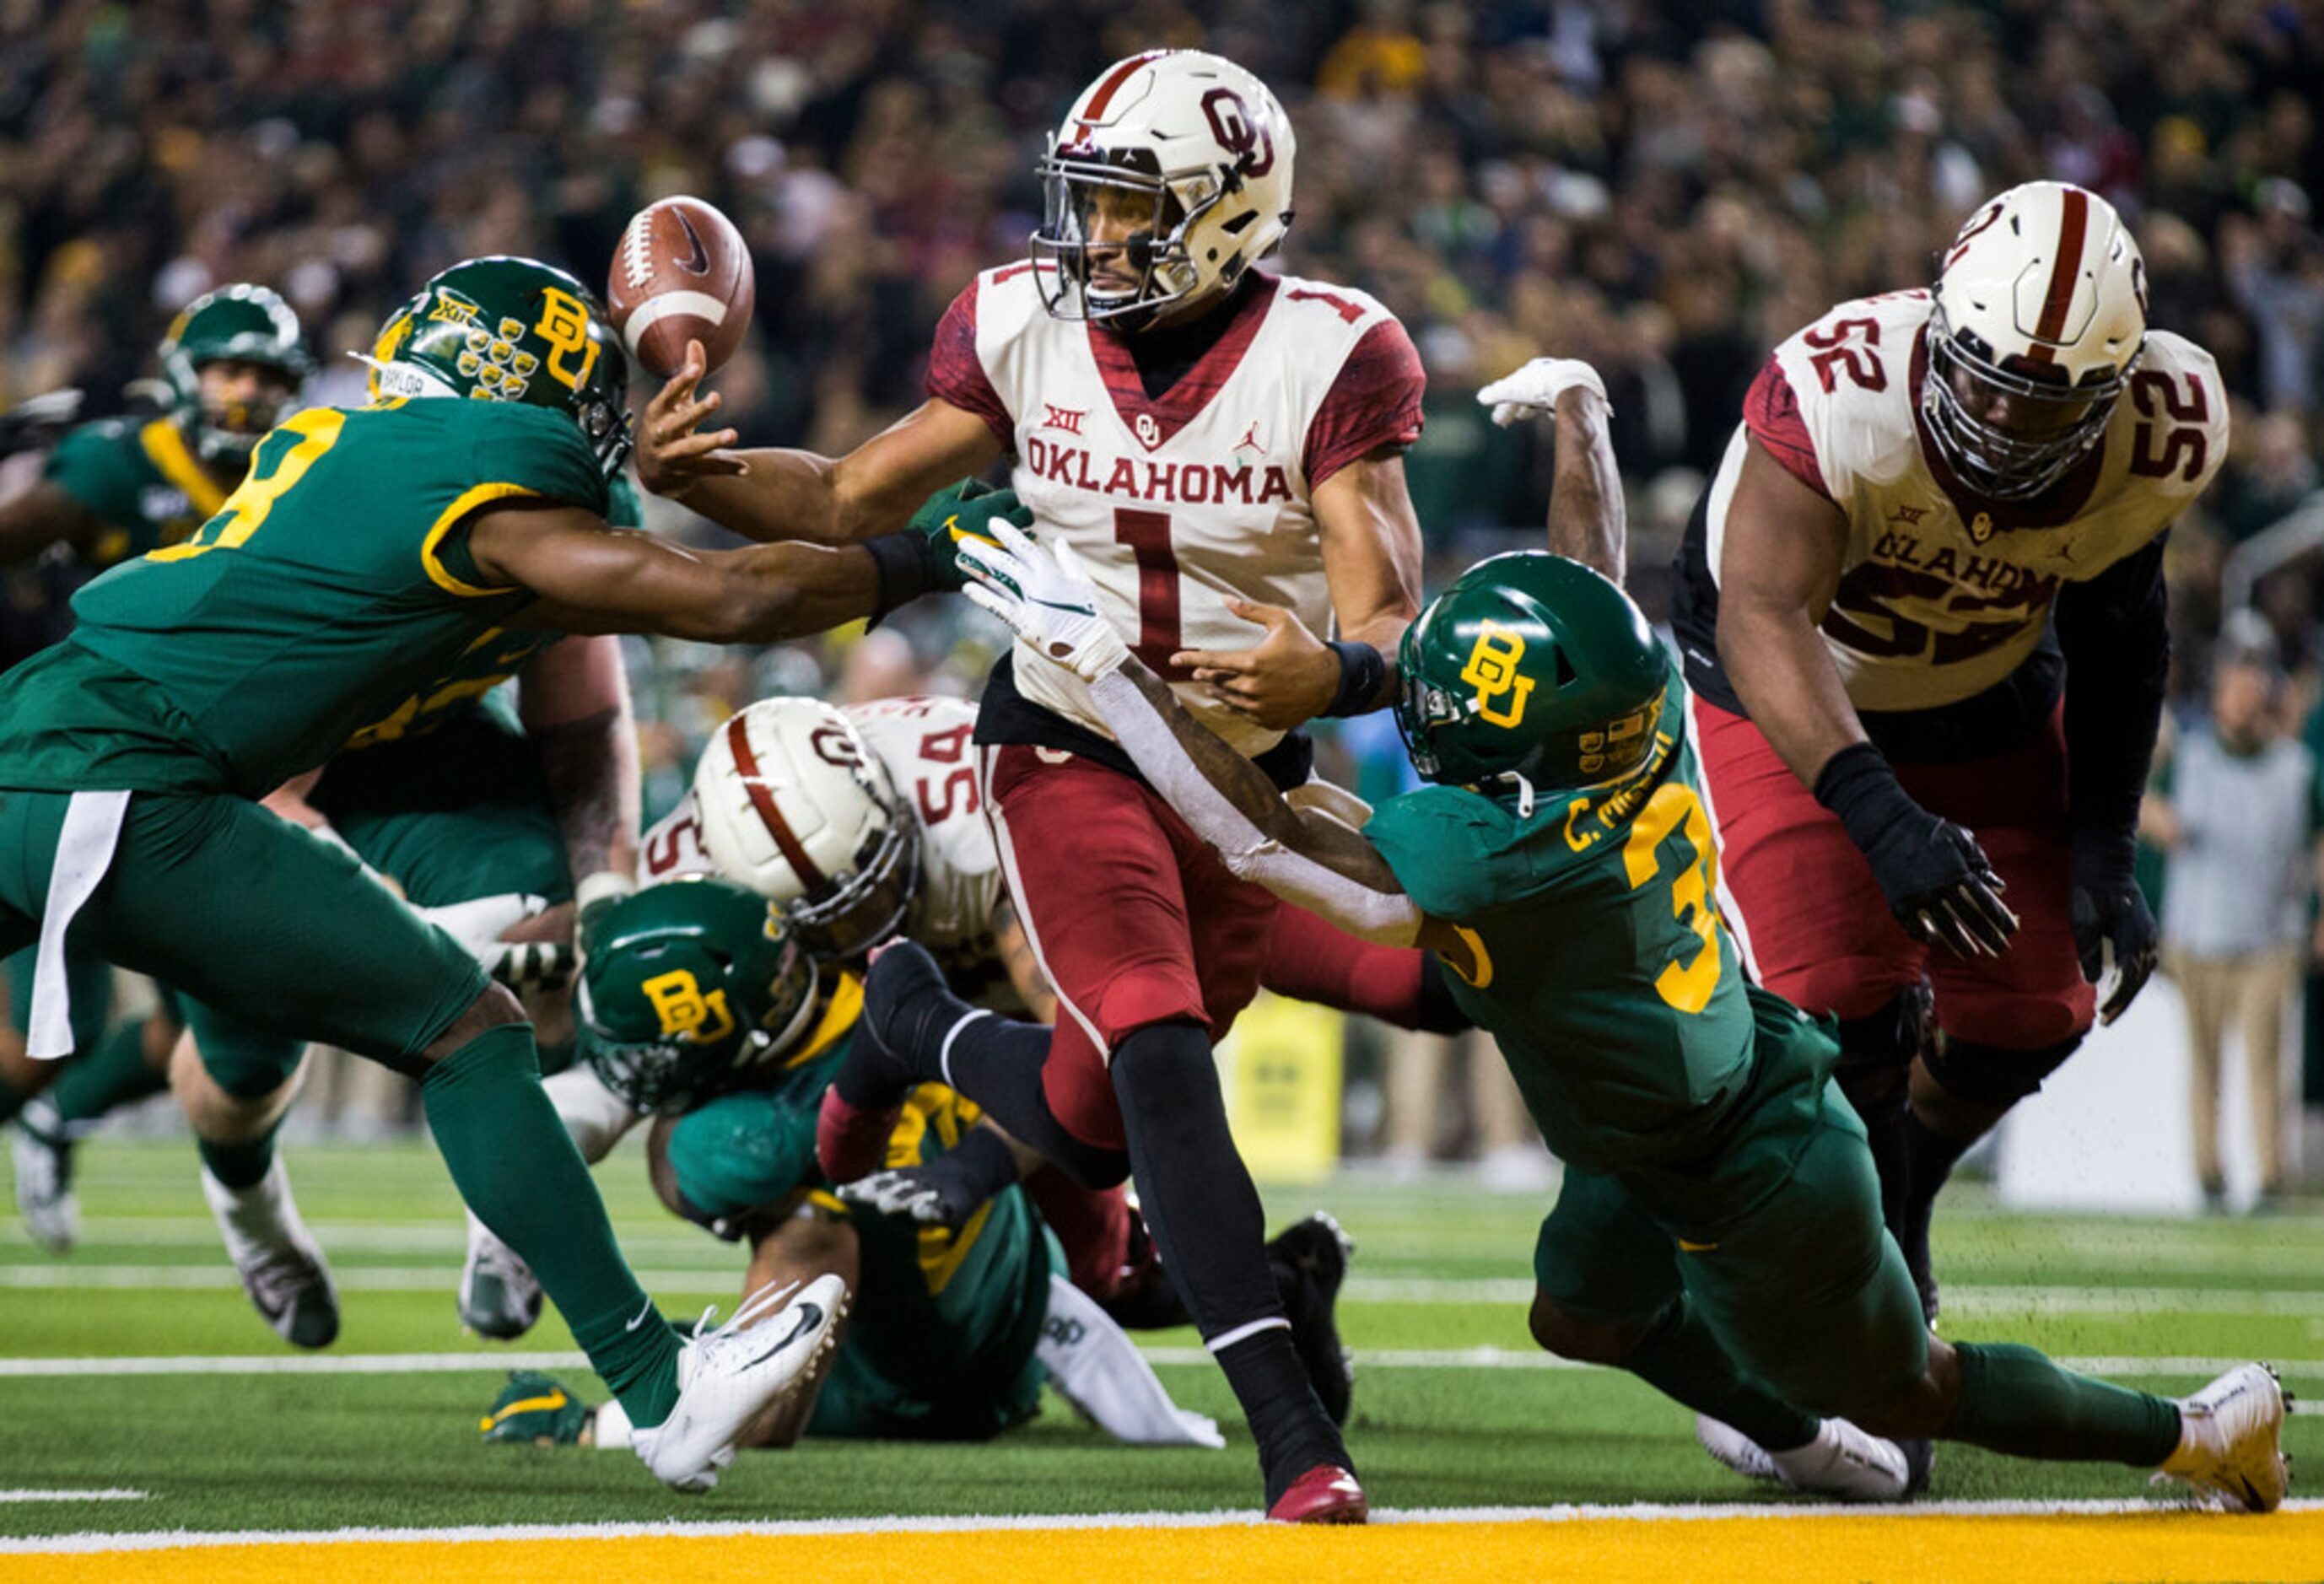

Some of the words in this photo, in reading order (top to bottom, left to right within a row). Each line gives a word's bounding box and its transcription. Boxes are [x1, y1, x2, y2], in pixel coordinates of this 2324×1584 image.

[535, 286, 601, 391] BU
[1286, 289, 1367, 324] 1
[1804, 317, 1888, 394] 52
[1028, 437, 1292, 504] OKLAHOMA
[1041, 404, 1087, 436] XII
[1136, 414, 1161, 443] OU
[2129, 369, 2209, 482] 52
[144, 407, 347, 563] 8
[1113, 508, 1201, 682] 1
[1818, 560, 2048, 666] 52
[1460, 617, 1536, 730] BU
[916, 724, 980, 828] 54
[1623, 782, 1721, 1015] 3
[642, 969, 735, 1044] BU
